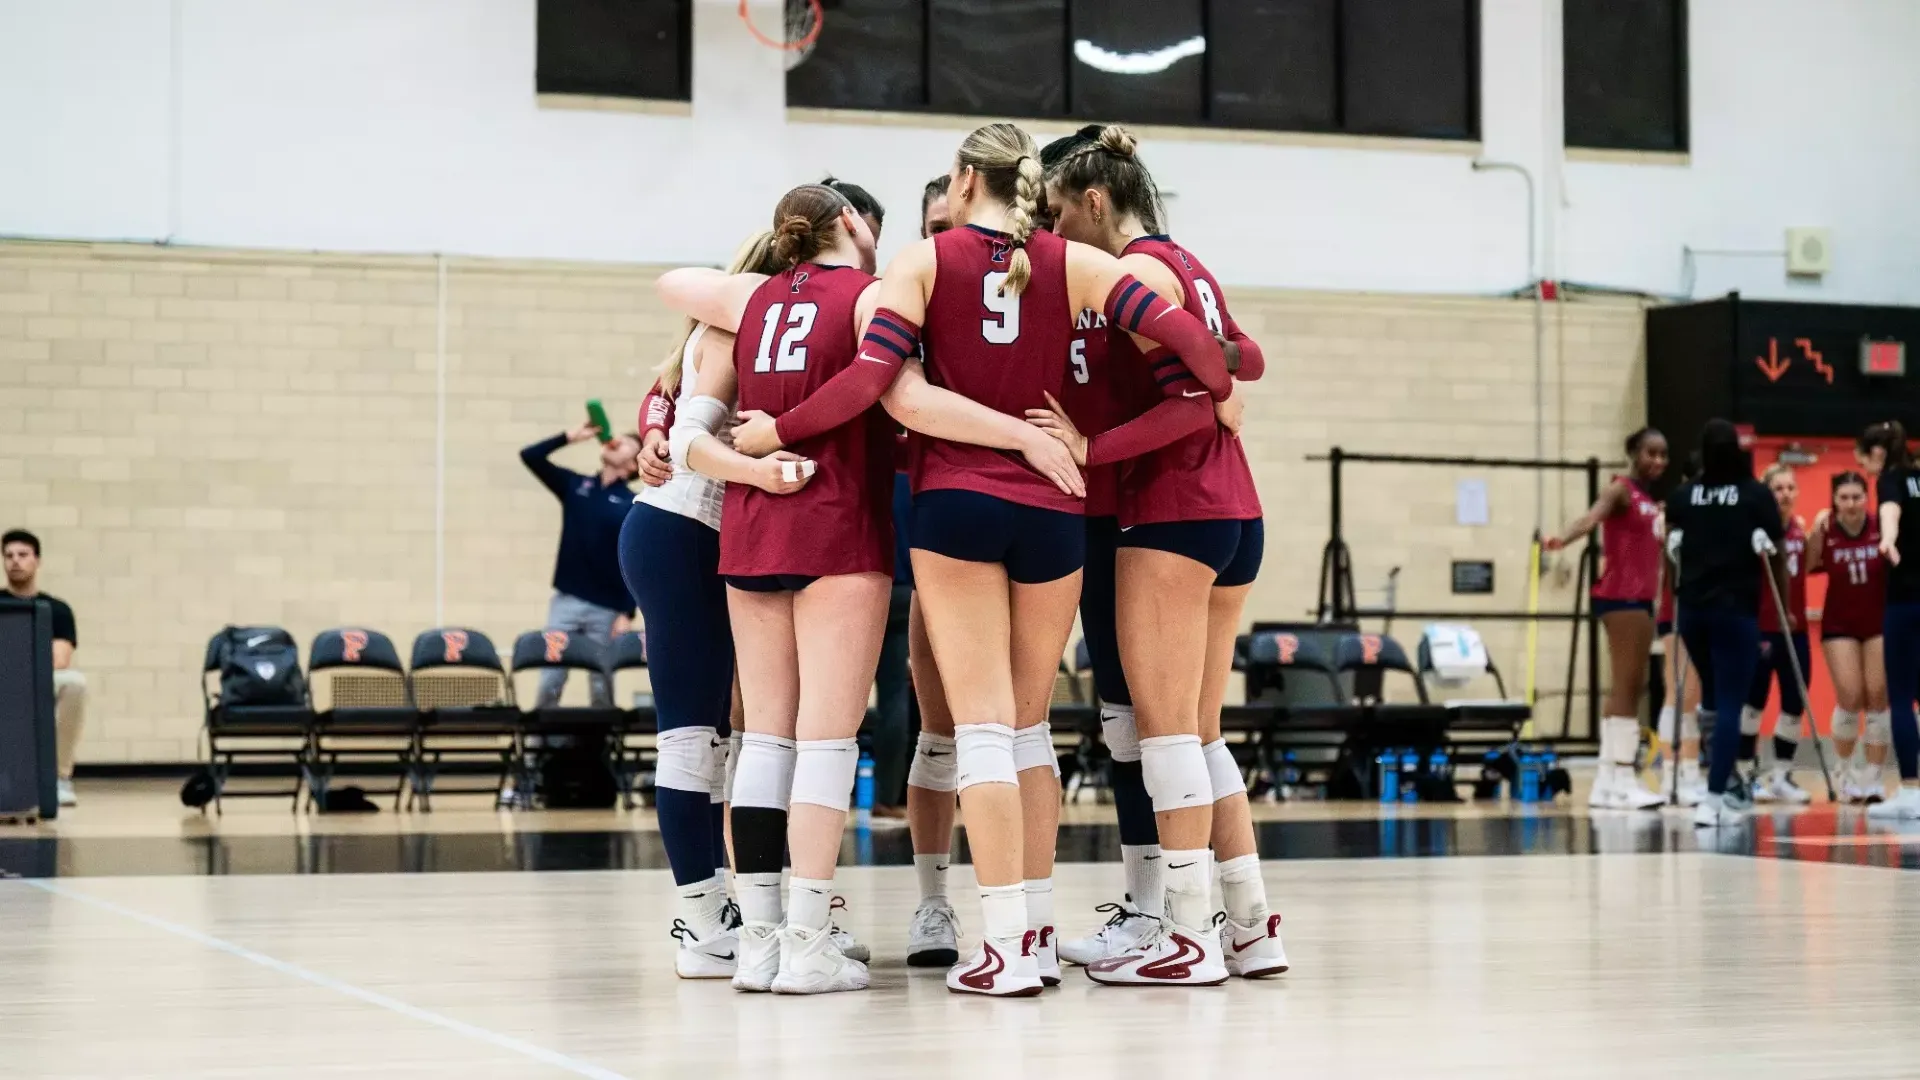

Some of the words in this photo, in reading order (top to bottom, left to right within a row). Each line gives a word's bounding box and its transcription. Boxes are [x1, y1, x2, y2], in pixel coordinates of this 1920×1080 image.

[991, 239, 1011, 262] P
[791, 271, 809, 294] P
[982, 269, 1021, 345] 9
[1192, 277, 1224, 337] 8
[754, 302, 819, 374] 12
[1069, 337, 1090, 384] 5
[1847, 561, 1868, 585] 11
